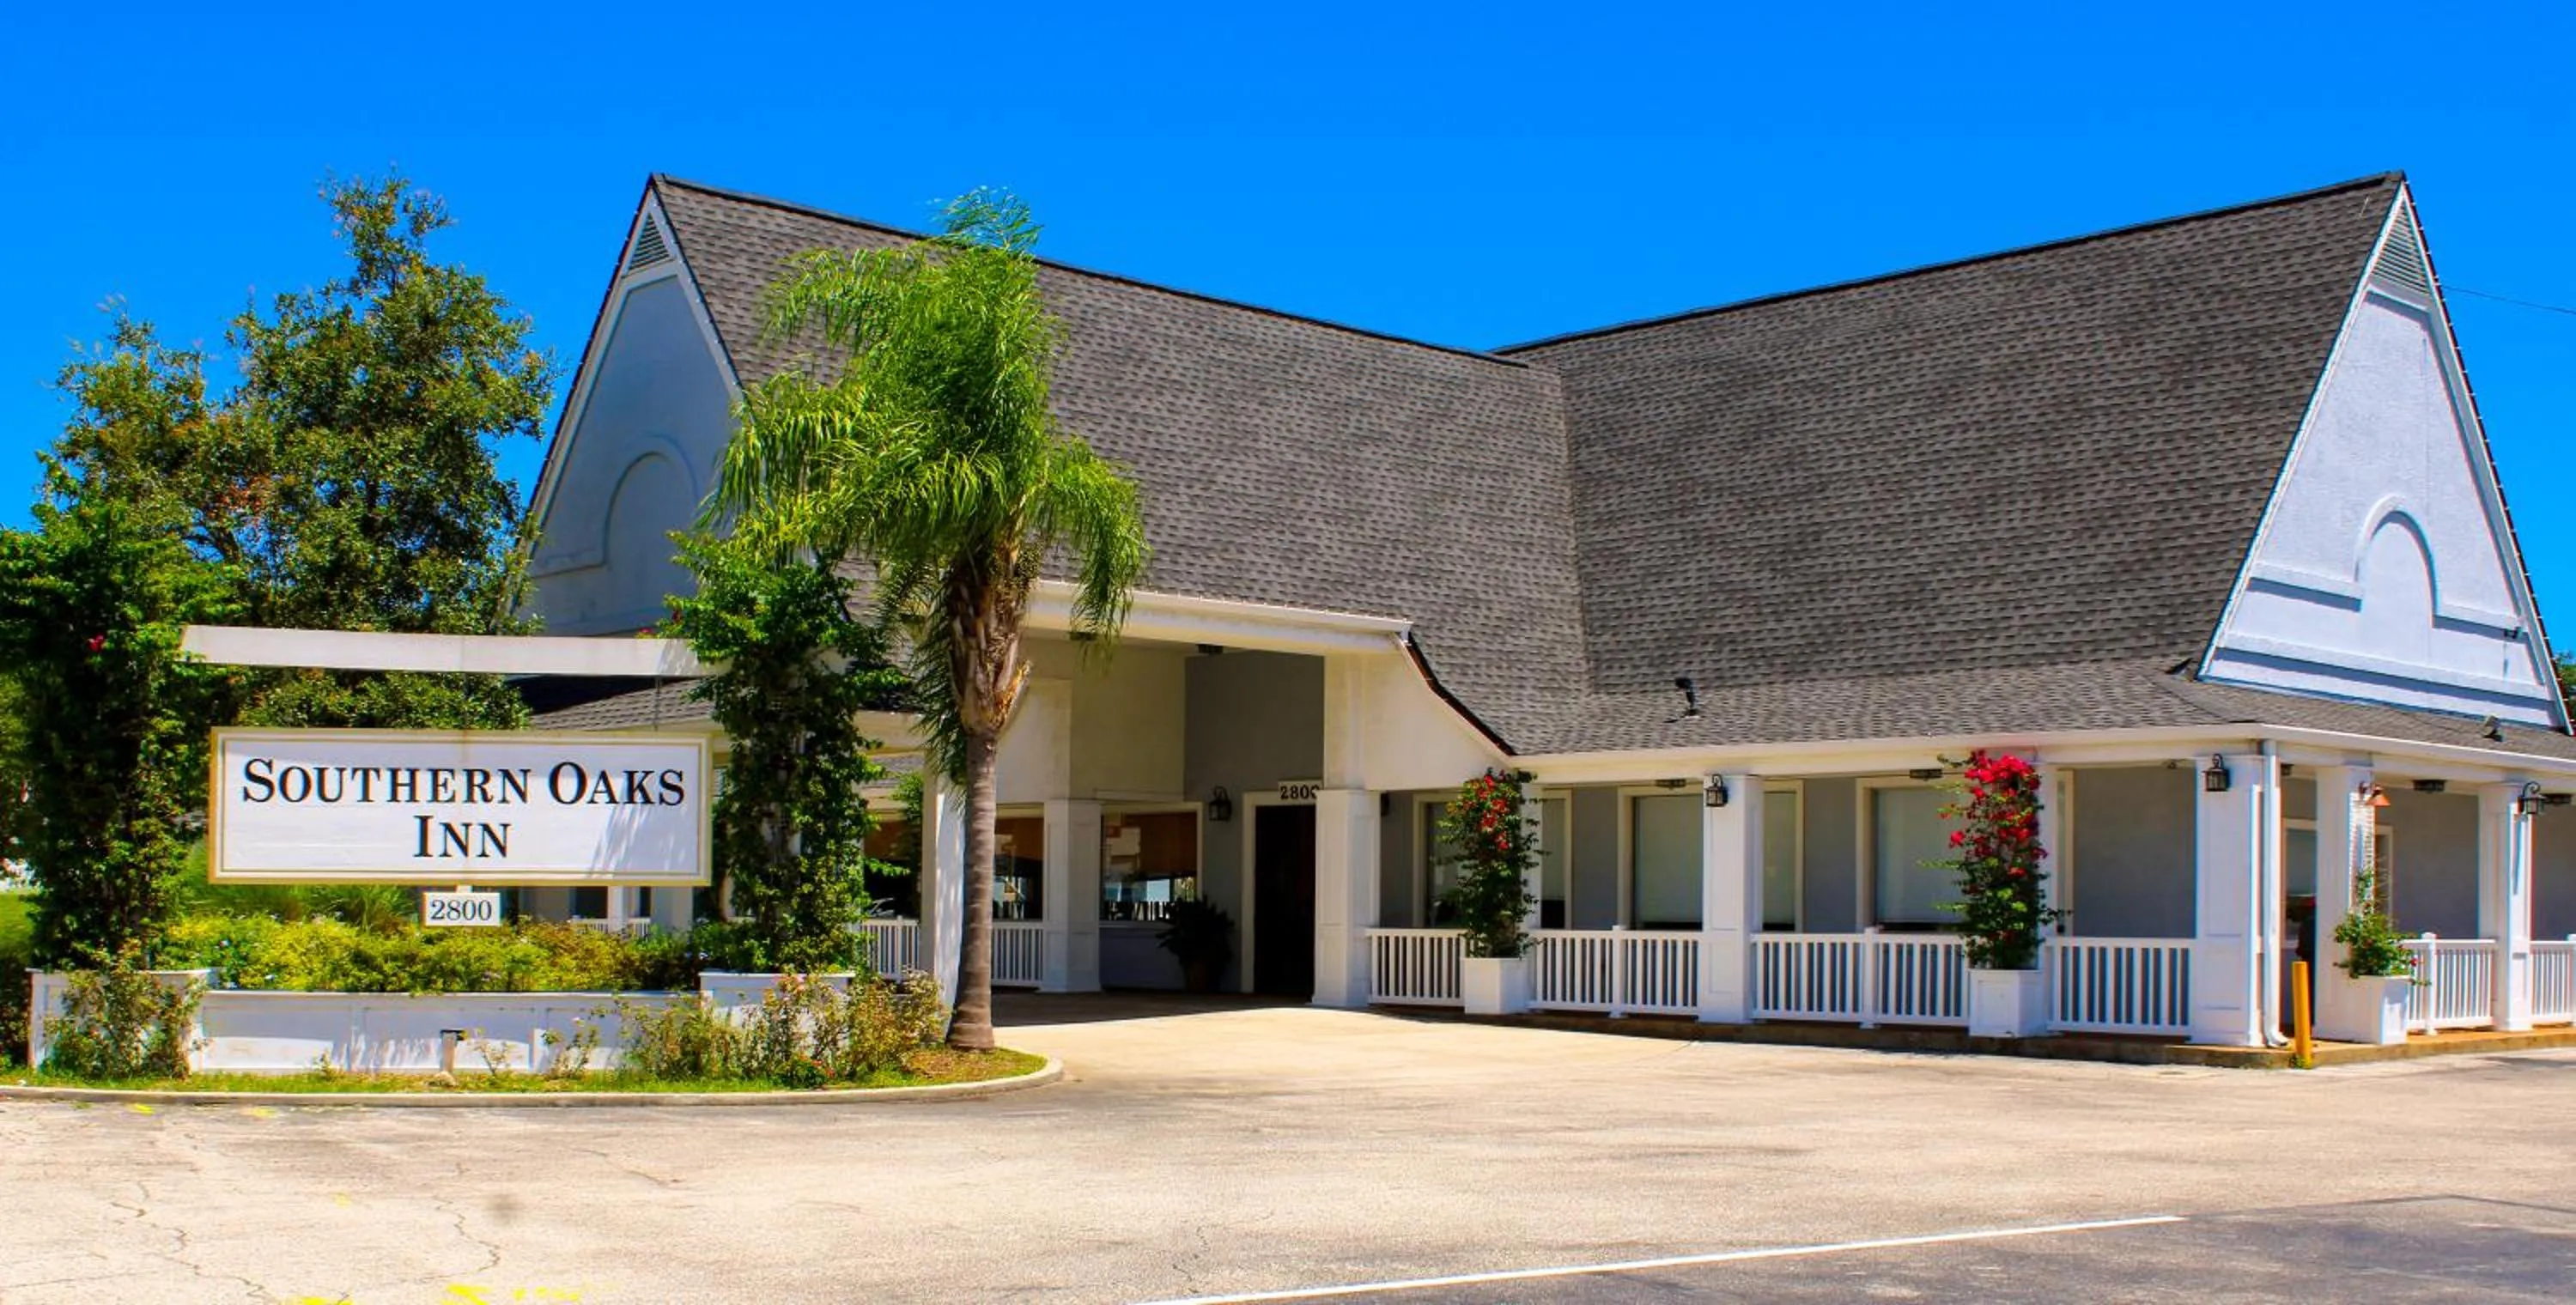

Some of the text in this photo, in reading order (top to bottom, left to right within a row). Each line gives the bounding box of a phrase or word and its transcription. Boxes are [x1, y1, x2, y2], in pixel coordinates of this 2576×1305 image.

[242, 758, 685, 805] SOUTHERN OAKS
[413, 815, 512, 858] INN
[430, 899, 492, 921] 2800
